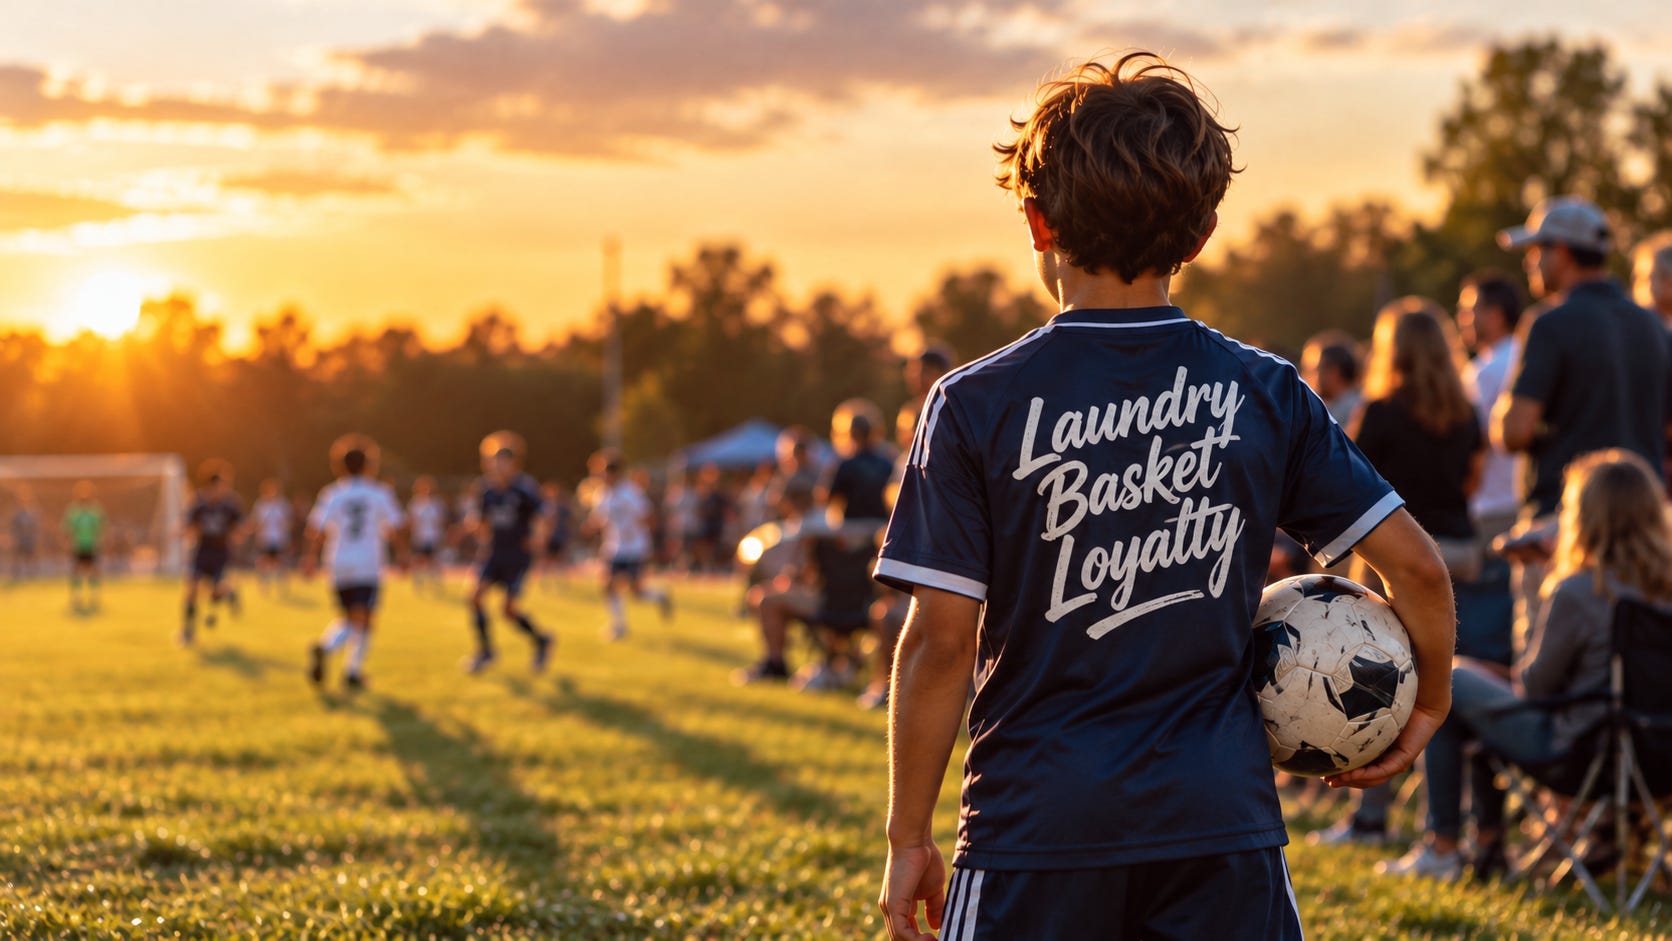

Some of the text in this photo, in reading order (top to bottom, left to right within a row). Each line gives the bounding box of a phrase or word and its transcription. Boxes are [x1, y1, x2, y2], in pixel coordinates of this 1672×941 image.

[1012, 365, 1246, 480] Laundry
[1037, 426, 1241, 541] Basket
[1044, 496, 1246, 623] Loyalty
